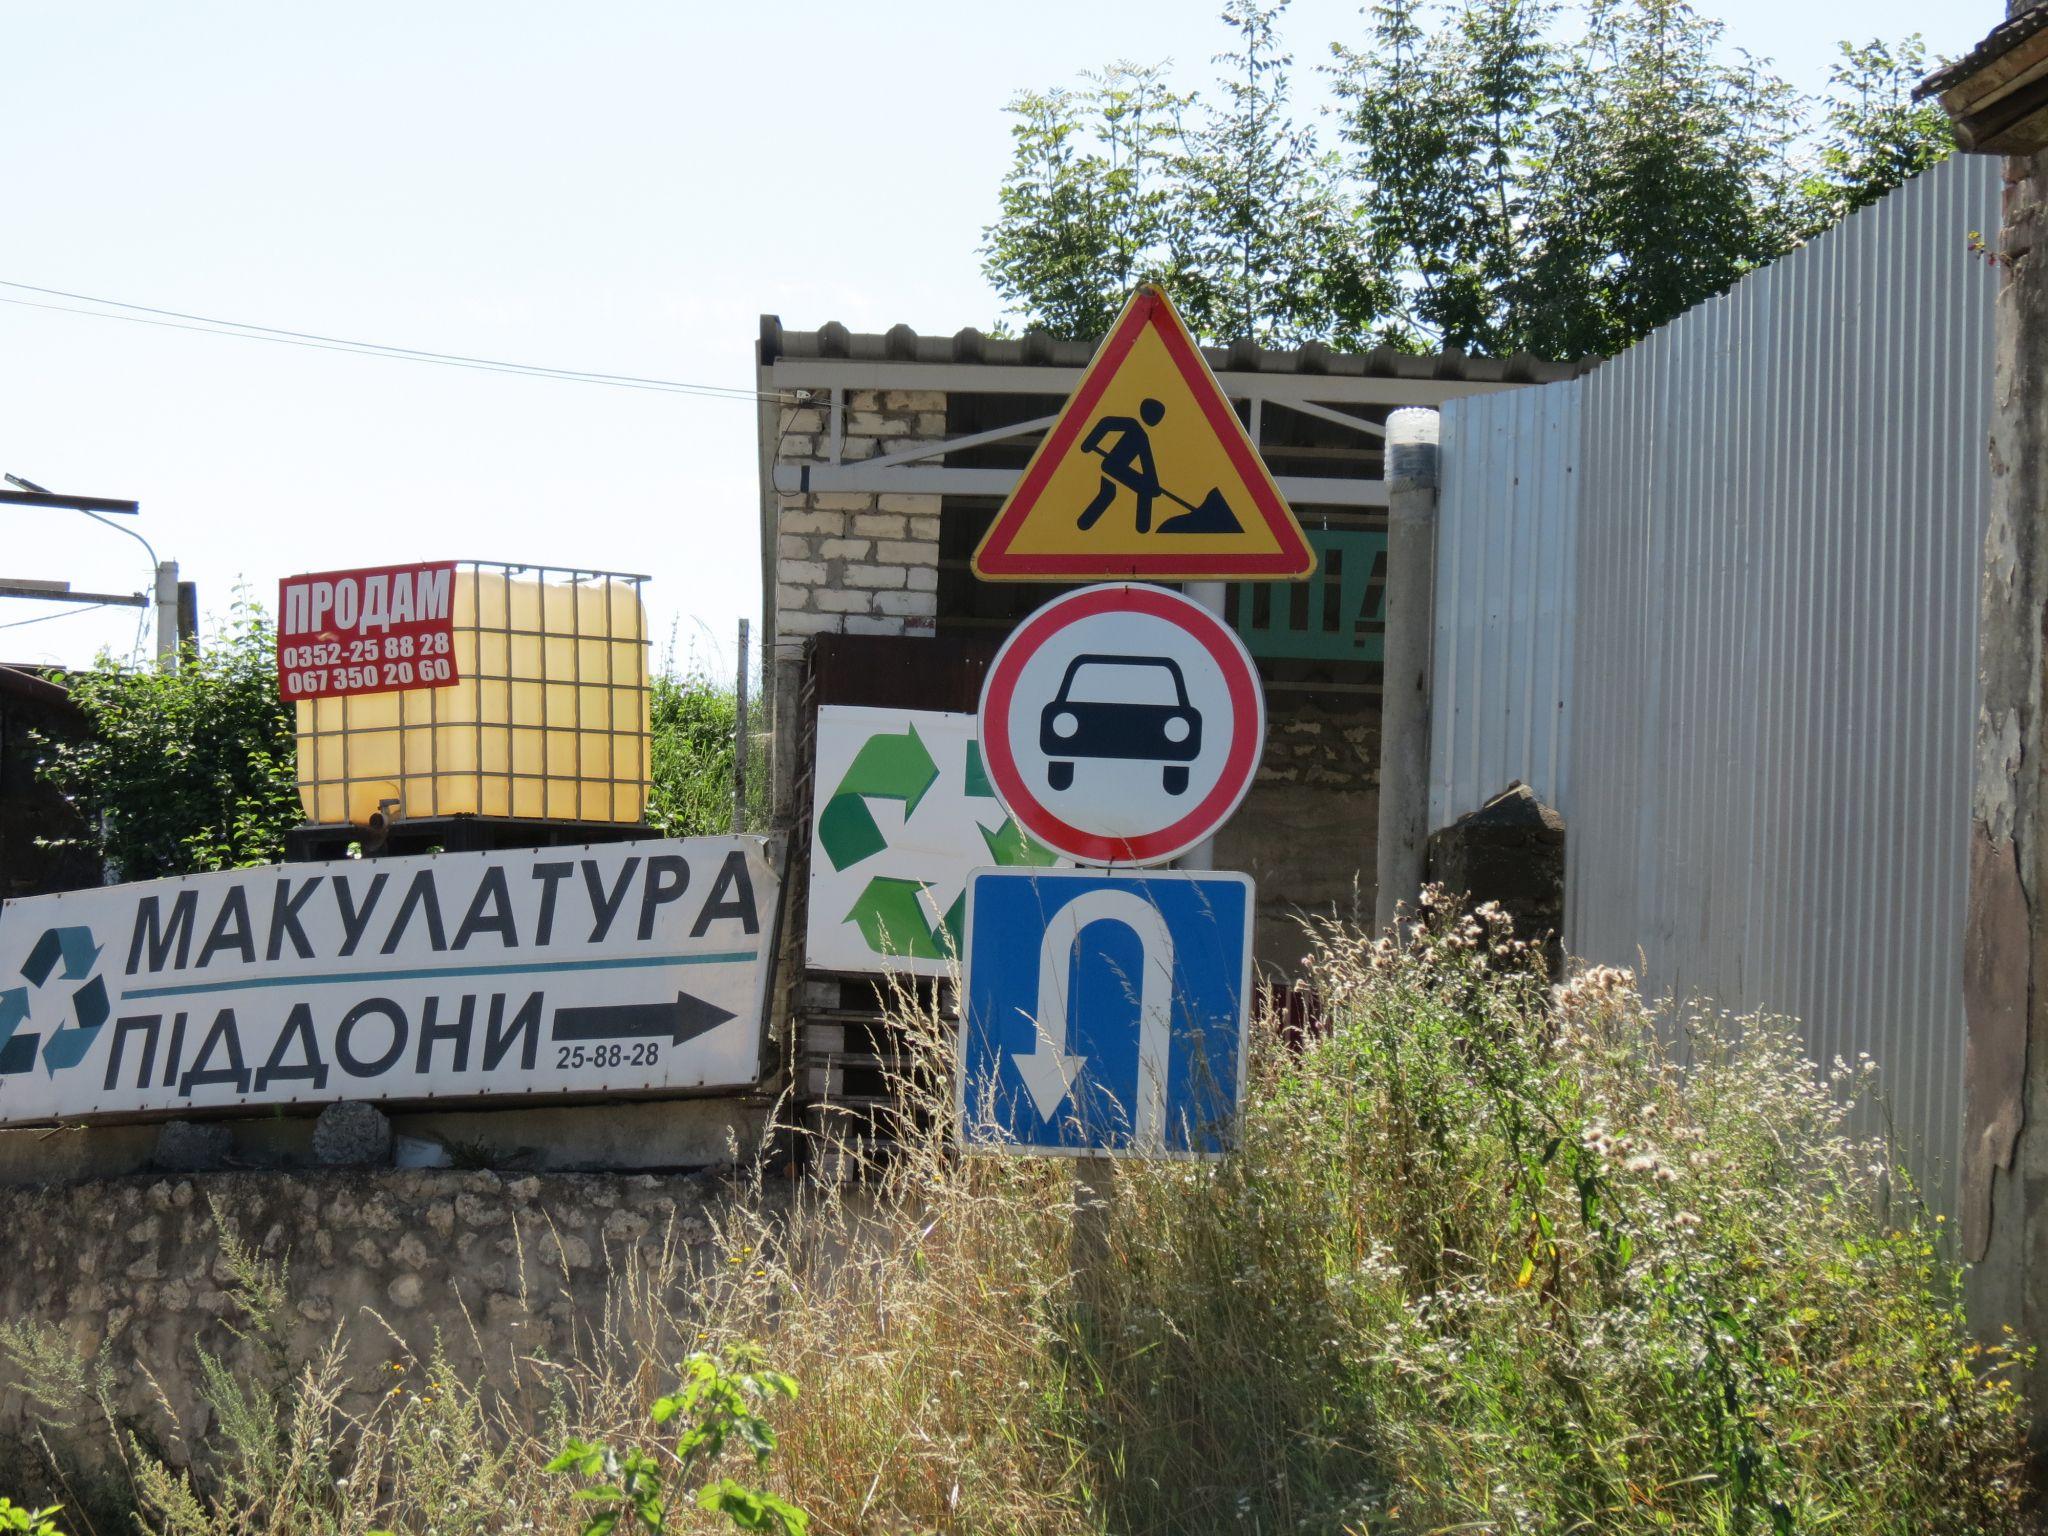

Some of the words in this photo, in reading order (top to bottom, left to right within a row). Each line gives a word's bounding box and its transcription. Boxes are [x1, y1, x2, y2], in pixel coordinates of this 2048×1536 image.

[286, 569, 451, 635] ПРОДАМ
[283, 640, 379, 669] 0352-25
[384, 635, 414, 659] 88
[419, 632, 449, 656] 28
[287, 670, 328, 694] 067
[332, 665, 379, 689] 350
[383, 661, 414, 685] 20
[418, 658, 451, 682] 60
[125, 851, 760, 975] МАКУЛАТУРА
[103, 991, 545, 1098] ПІДДОНИ
[556, 1042, 660, 1070] 25-88-28
